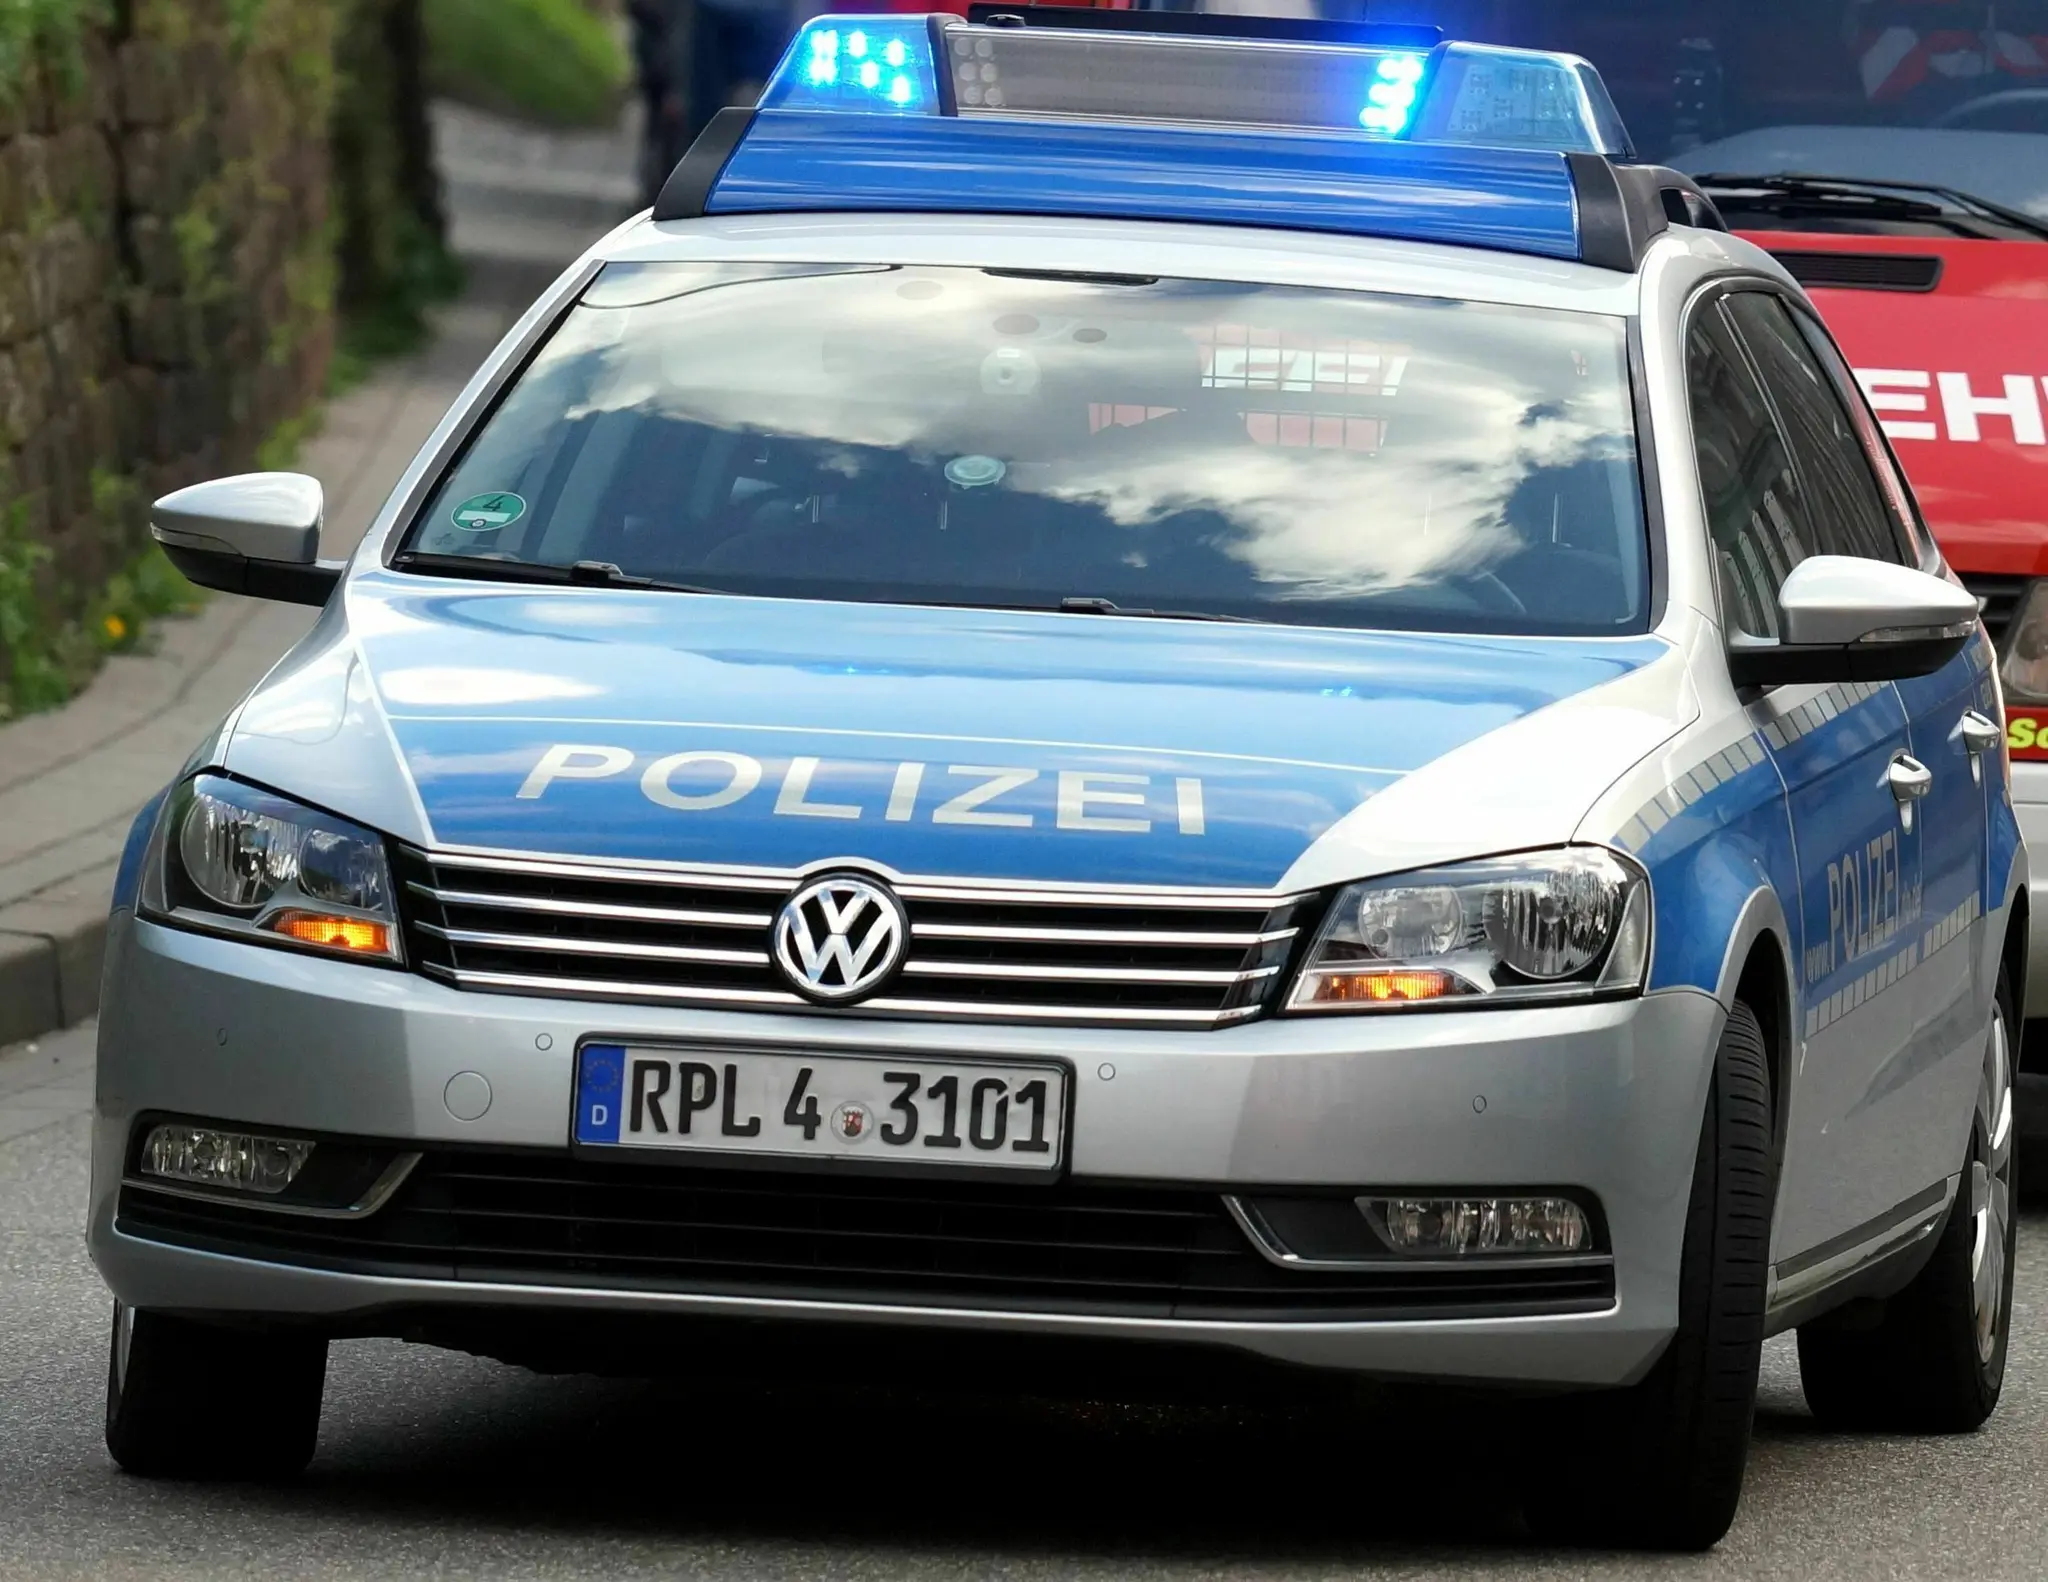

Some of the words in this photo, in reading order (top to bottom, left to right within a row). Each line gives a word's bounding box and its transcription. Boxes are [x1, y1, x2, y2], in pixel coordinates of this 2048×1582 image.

[1852, 367, 2048, 446] EH
[482, 494, 506, 512] 4
[515, 743, 1206, 836] POLIZEI
[591, 1104, 609, 1126] D
[629, 1059, 761, 1137] RPL
[783, 1067, 822, 1140] 4
[880, 1071, 1050, 1152] 3101
